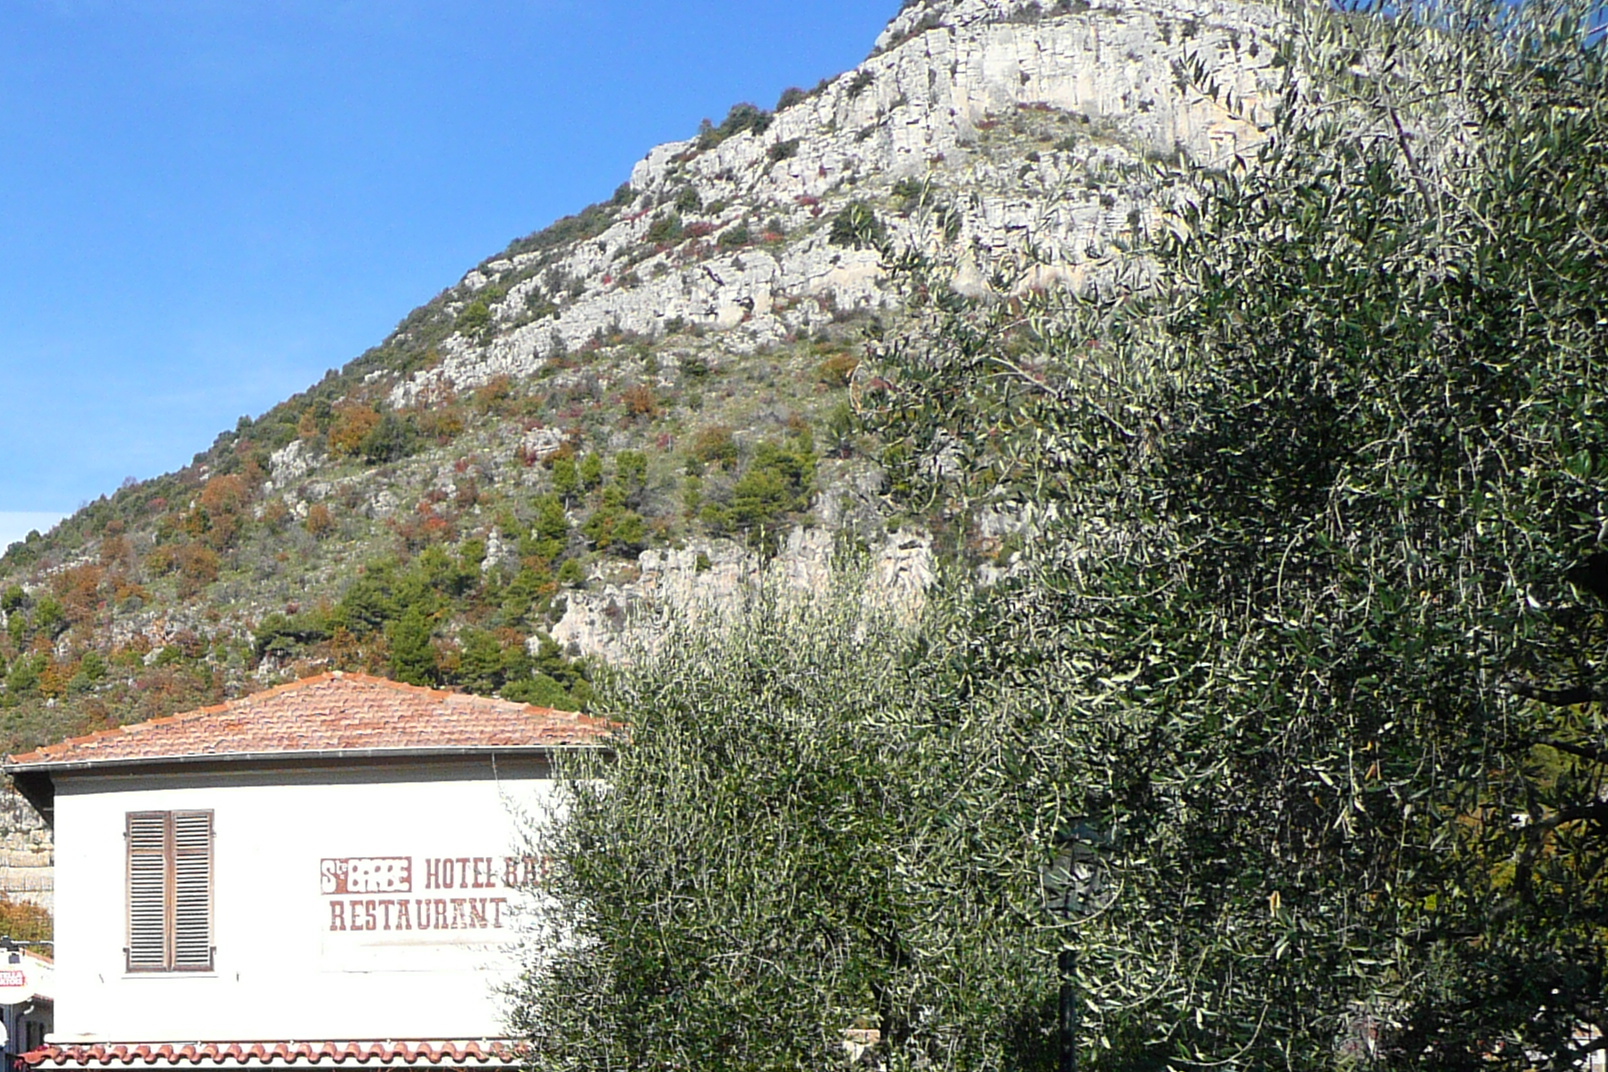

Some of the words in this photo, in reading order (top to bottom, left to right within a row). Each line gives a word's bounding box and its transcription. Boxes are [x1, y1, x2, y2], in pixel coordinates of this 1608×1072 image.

[347, 858, 410, 892] BARBE
[425, 857, 496, 889] HOTEL
[329, 896, 507, 931] RESTAURANT
